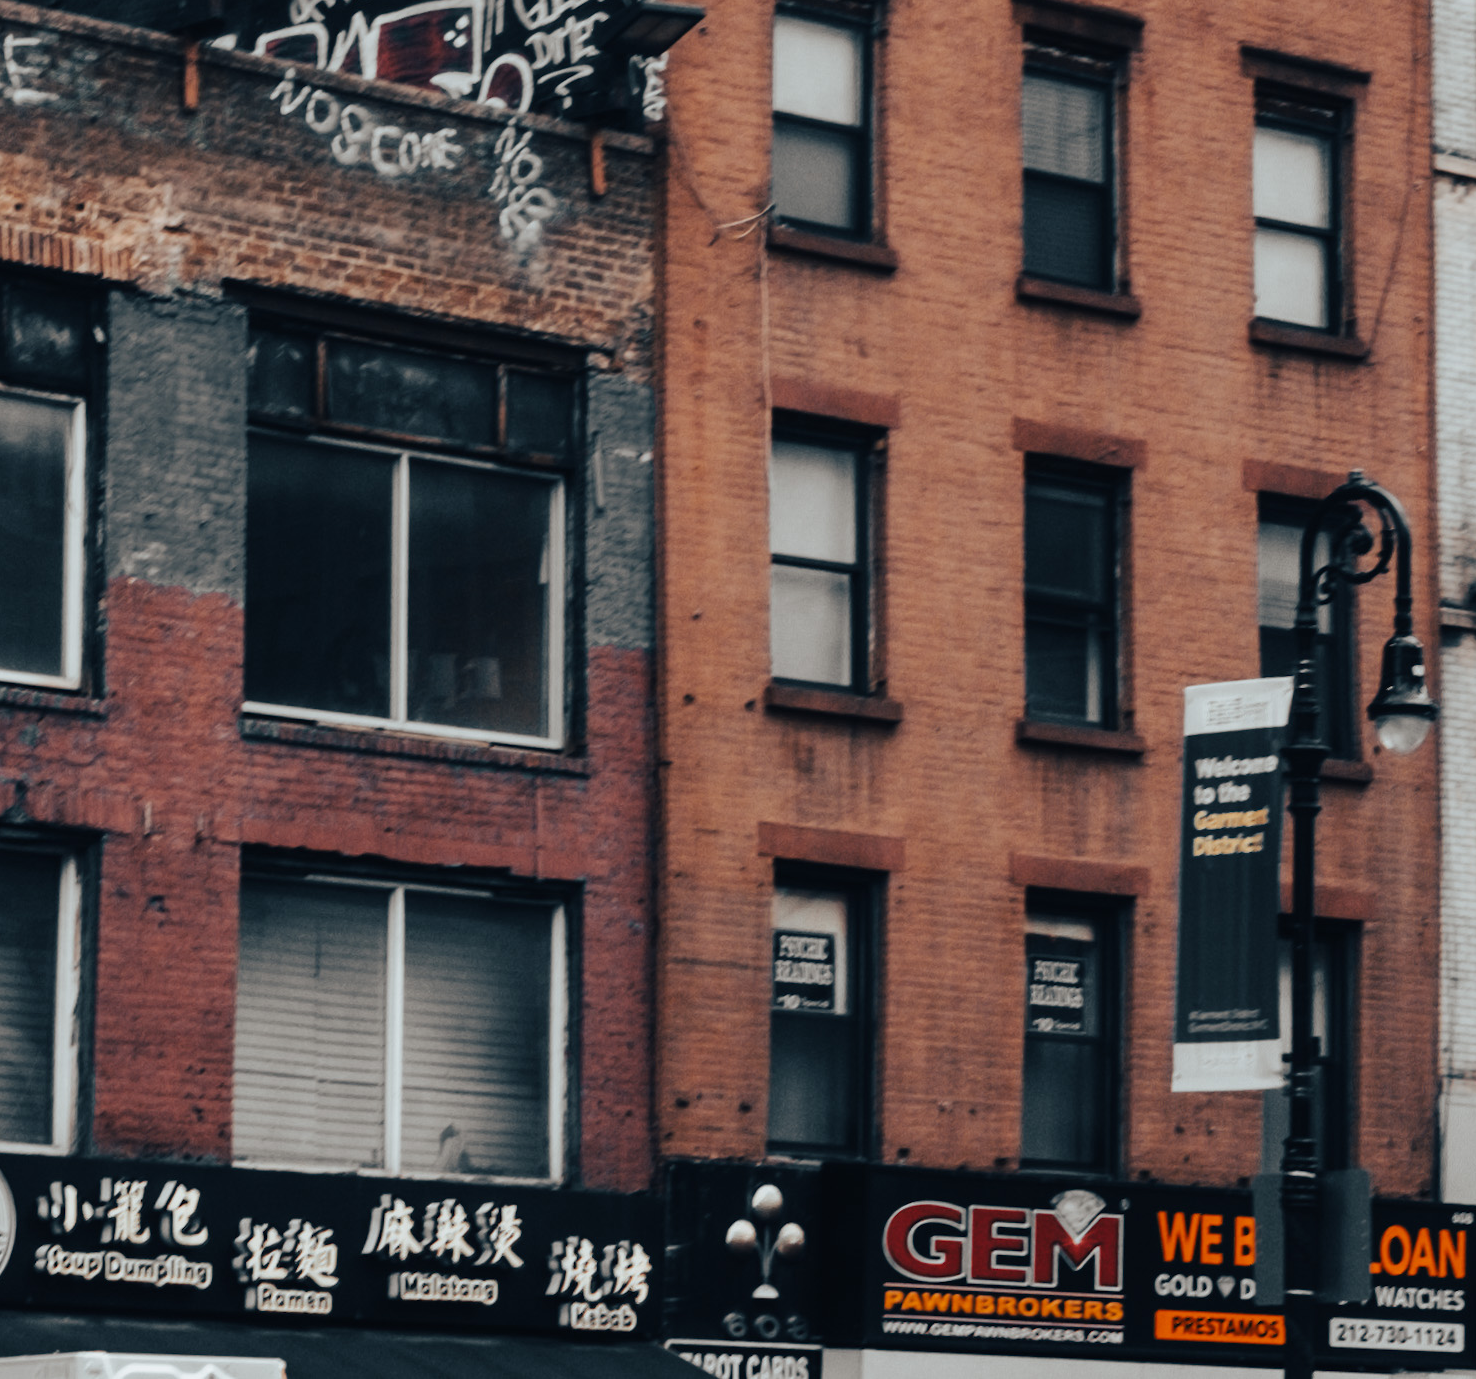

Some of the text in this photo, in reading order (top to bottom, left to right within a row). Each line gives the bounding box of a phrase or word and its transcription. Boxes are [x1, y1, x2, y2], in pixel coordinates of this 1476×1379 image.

[1195, 755, 1279, 780] Welcome
[1193, 780, 1251, 805] to the
[882, 1200, 1124, 1291] GEM
[1157, 1211, 1223, 1265] WE
[46, 1244, 213, 1290] Soup Dumpling
[257, 1282, 332, 1314] Ramen
[883, 1290, 1124, 1322] PAWNBROKERS
[1155, 1273, 1213, 1298] GOLD
[1374, 1286, 1465, 1311] WATCHES
[570, 1301, 637, 1332] Kebab
[1172, 1315, 1279, 1338] PRESTAMOS
[882, 1321, 1124, 1344] WWW.GEMPAWNBROKERS.COM
[1336, 1323, 1456, 1346] 212-730-1124
[746, 1354, 809, 1379] CARDS
